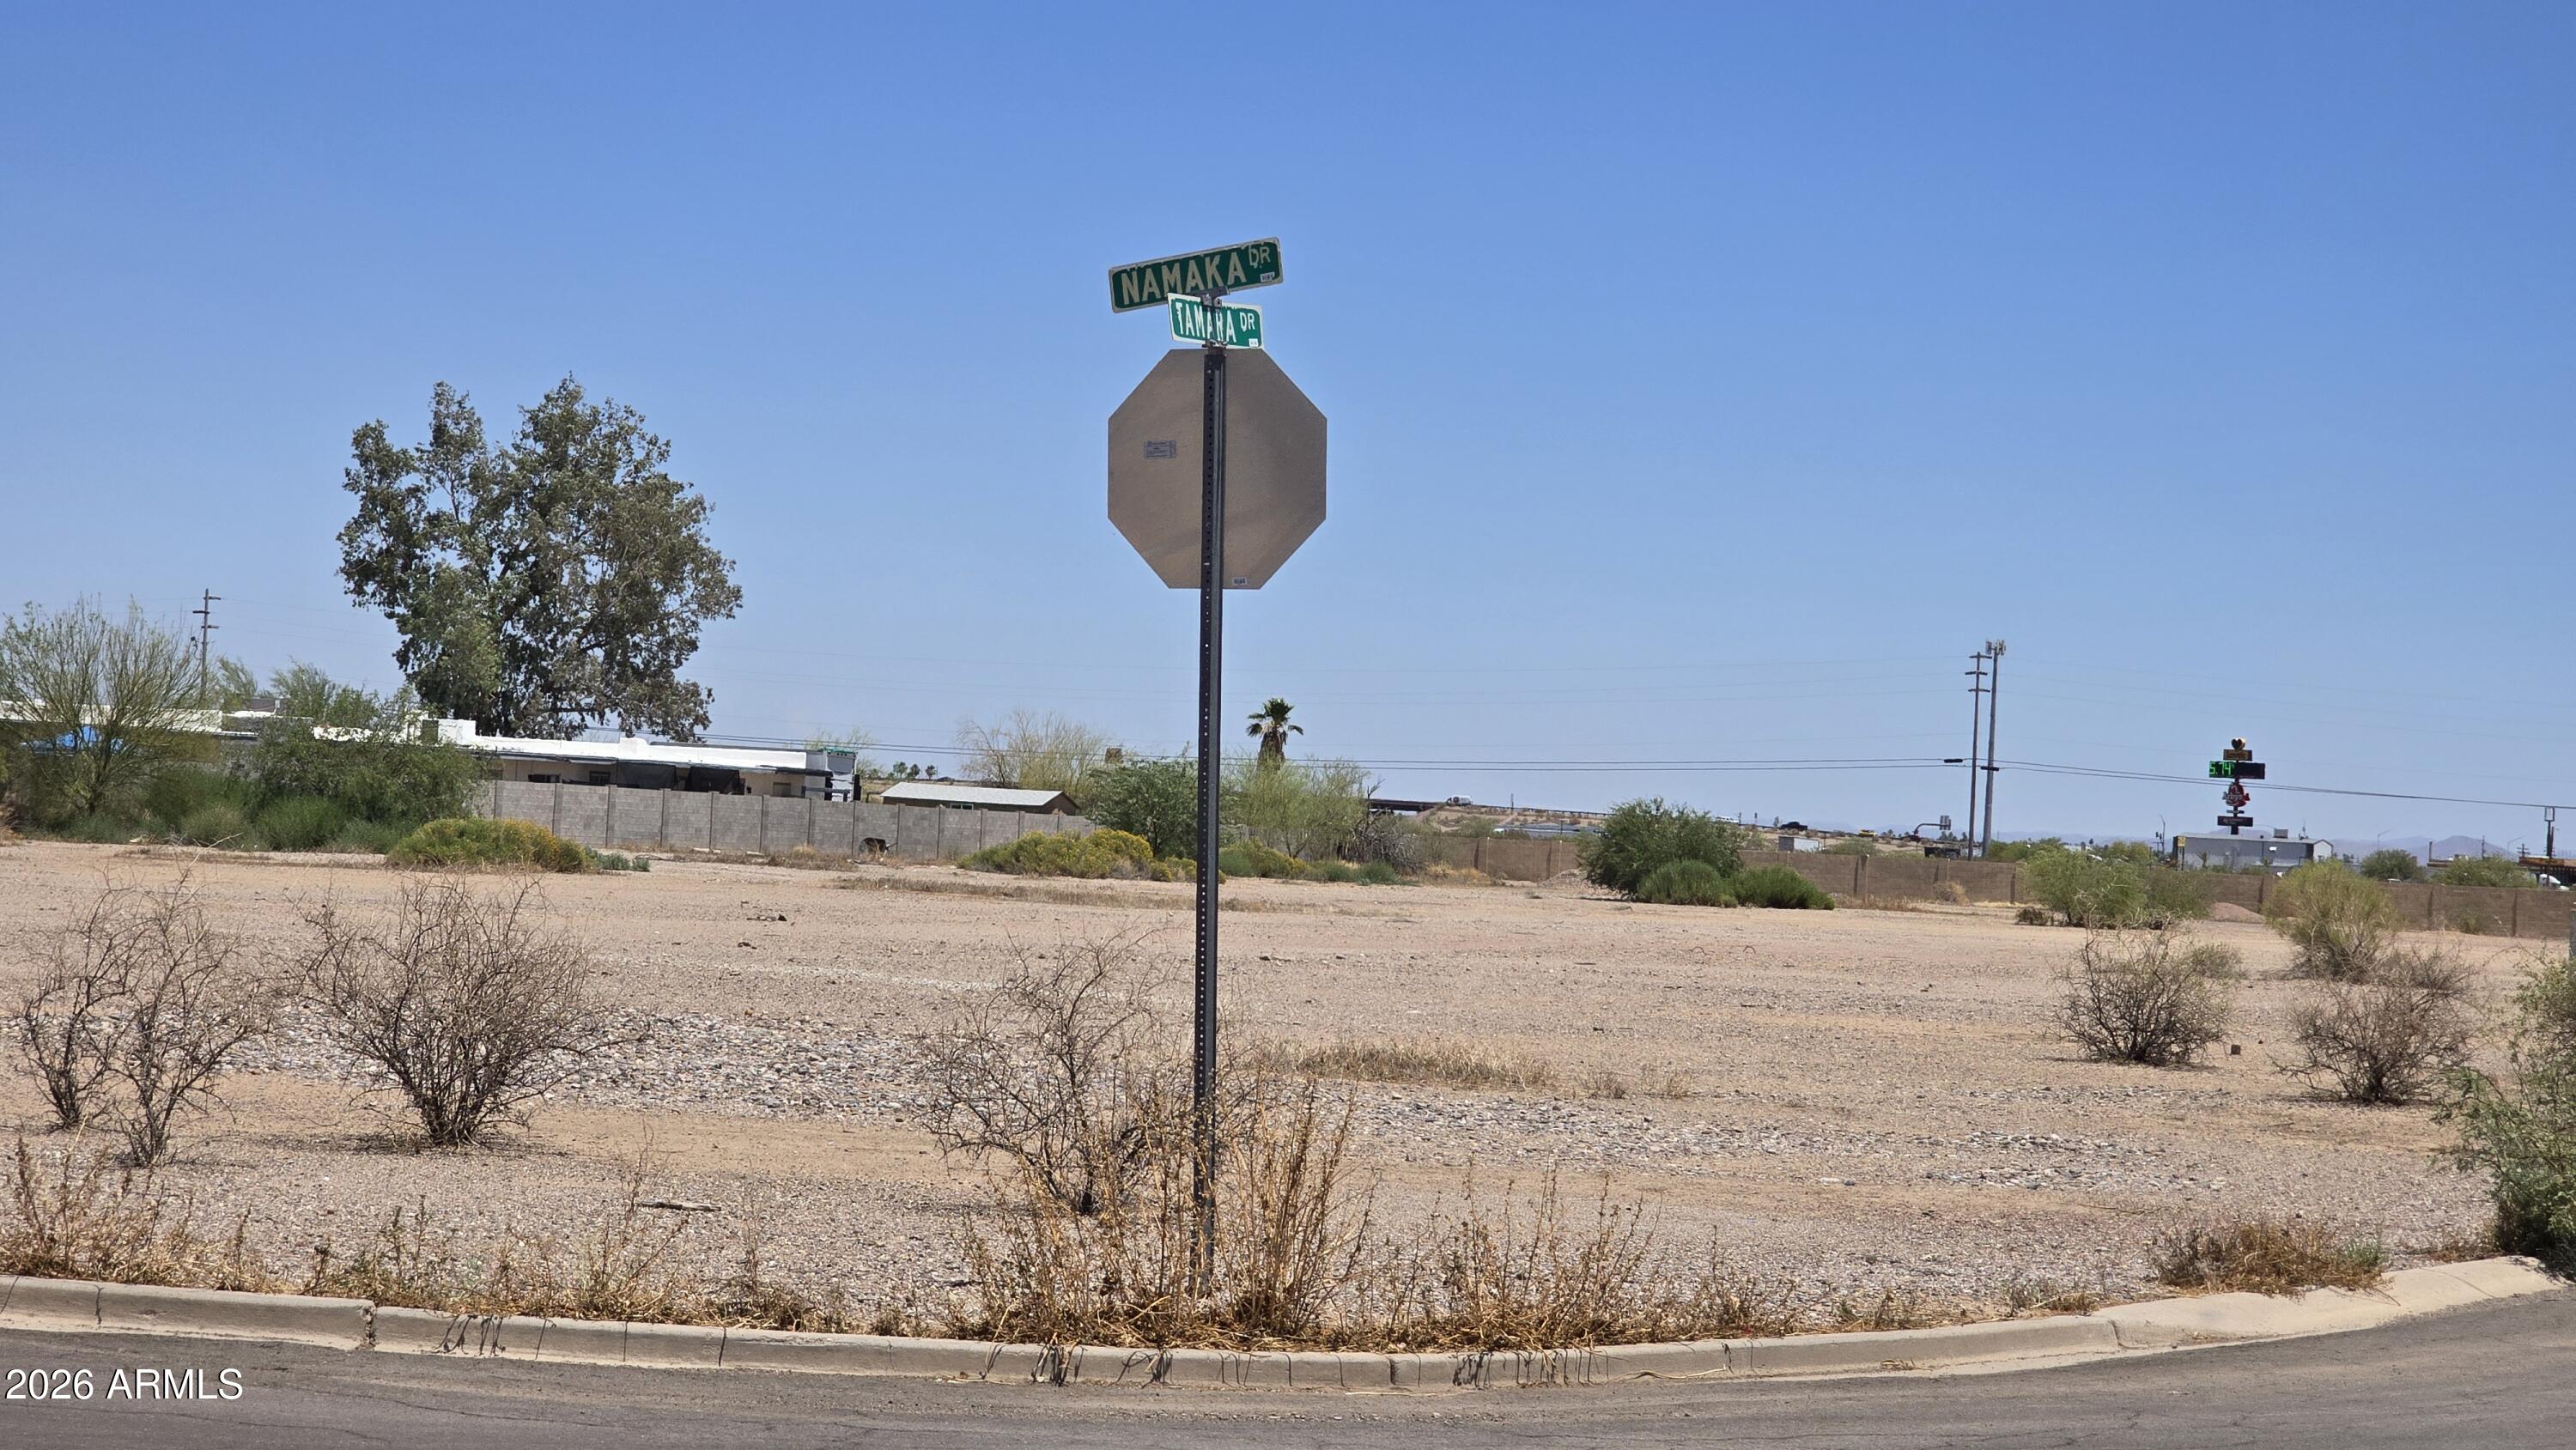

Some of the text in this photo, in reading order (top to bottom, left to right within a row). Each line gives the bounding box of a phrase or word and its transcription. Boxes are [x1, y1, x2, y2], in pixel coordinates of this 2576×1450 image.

[1121, 245, 1271, 305] NAMAKA DR
[1239, 312, 1255, 332] DR
